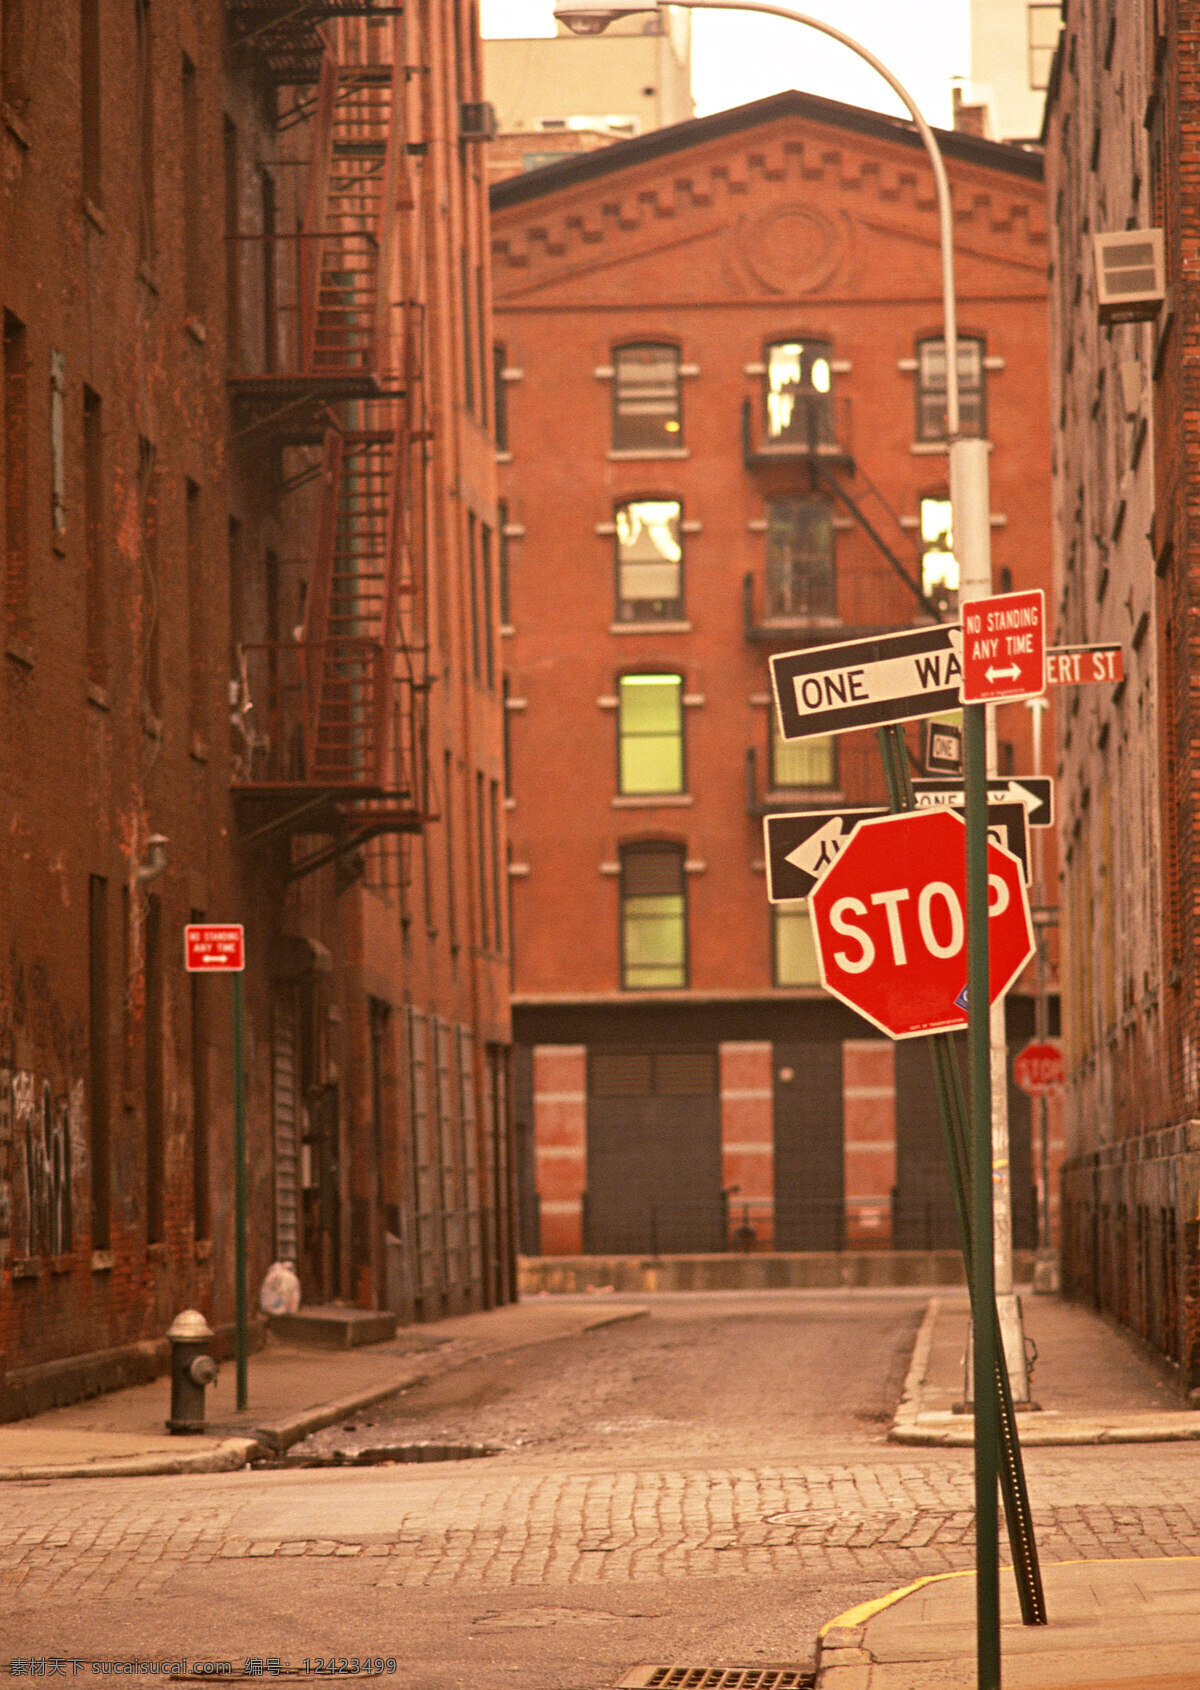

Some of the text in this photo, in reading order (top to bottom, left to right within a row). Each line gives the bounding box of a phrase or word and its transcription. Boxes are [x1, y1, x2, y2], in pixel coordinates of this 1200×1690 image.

[966, 606, 1038, 634] NO STANDING
[972, 633, 1034, 661] ANY TIME
[801, 653, 962, 709] ONE WA
[1046, 651, 1115, 684] ERT ST
[934, 737, 953, 757] ONE
[193, 943, 213, 953] ANY
